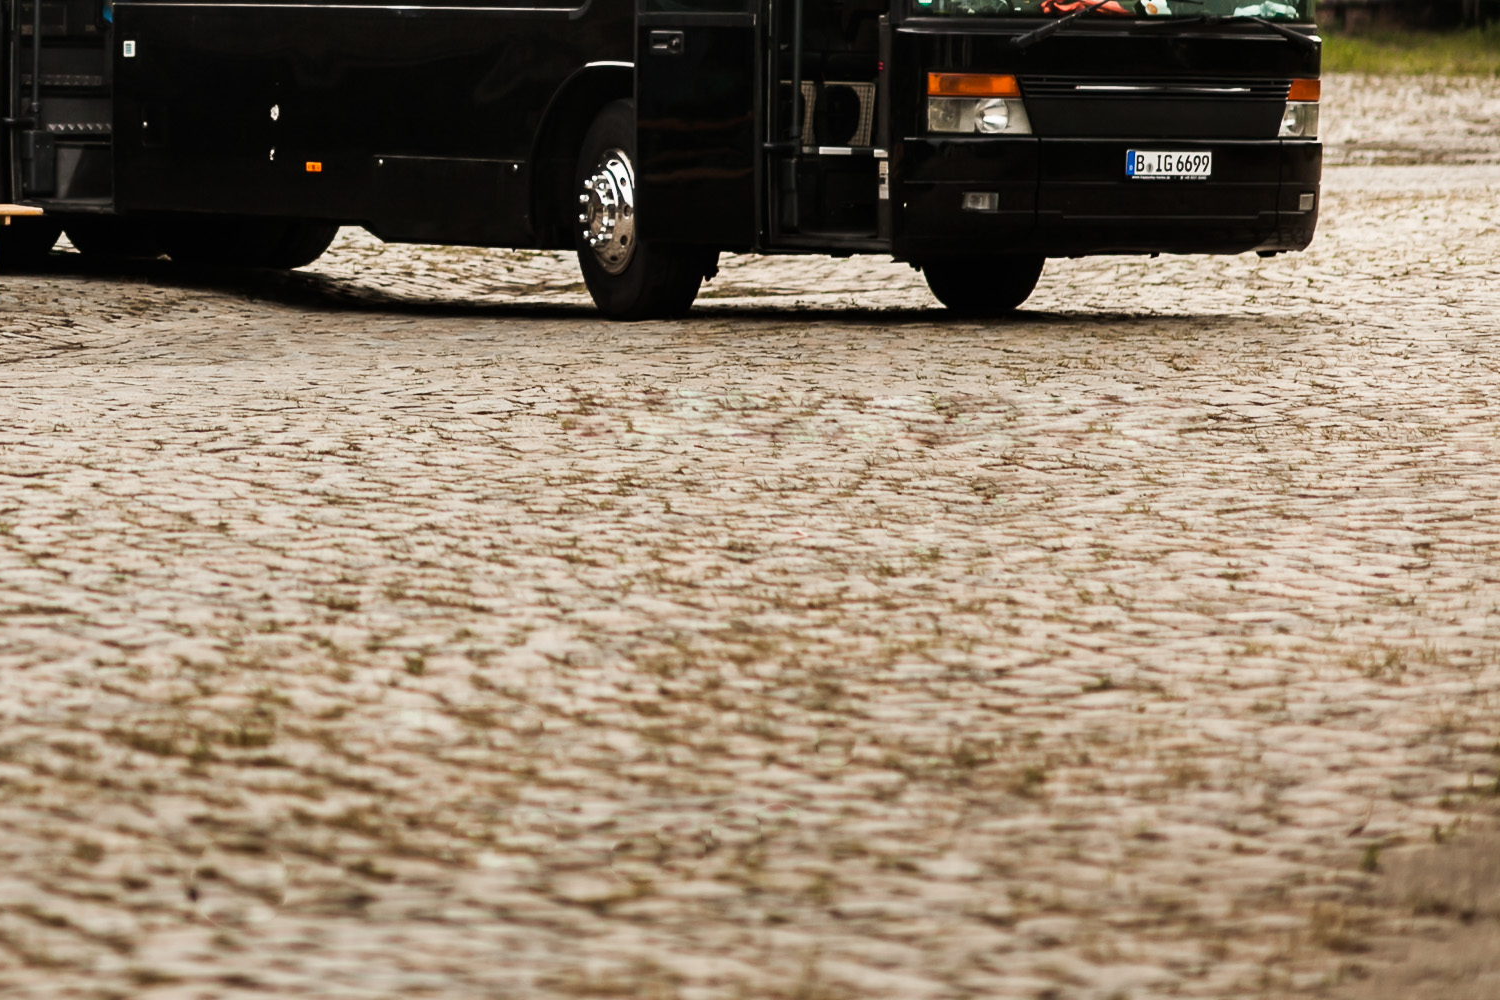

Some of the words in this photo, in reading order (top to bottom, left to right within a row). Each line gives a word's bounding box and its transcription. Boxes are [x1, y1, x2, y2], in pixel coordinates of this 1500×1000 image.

[1136, 154, 1145, 172] B
[1156, 154, 1173, 172] IG
[1176, 154, 1210, 173] 6699
